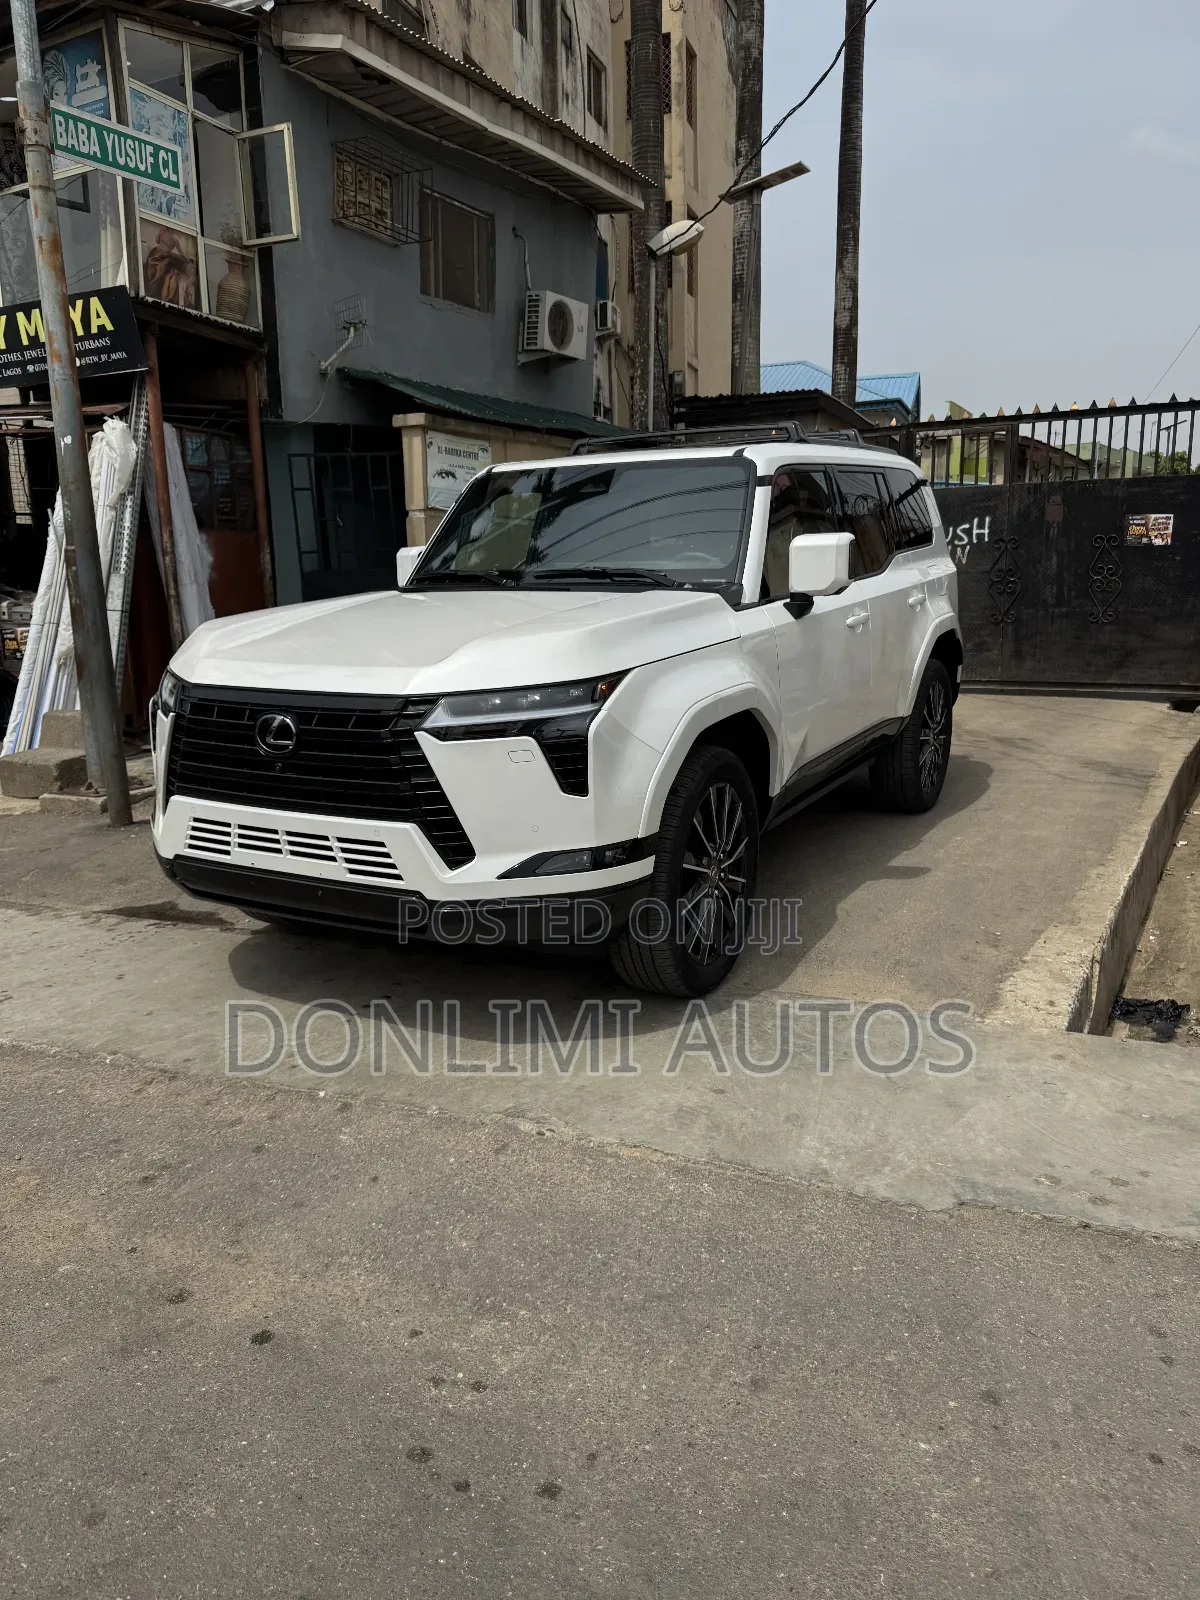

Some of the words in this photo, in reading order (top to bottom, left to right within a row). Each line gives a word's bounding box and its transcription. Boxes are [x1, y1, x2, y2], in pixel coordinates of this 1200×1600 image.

[55, 113, 101, 158] BABA
[103, 130, 154, 173] YUSUF
[159, 149, 178, 182] CL
[16, 296, 115, 346] MYA
[24, 348, 47, 361] JEWEL
[74, 336, 111, 351] TURBANS
[34, 363, 49, 372] 0704
[462, 449, 480, 461] CENTRE
